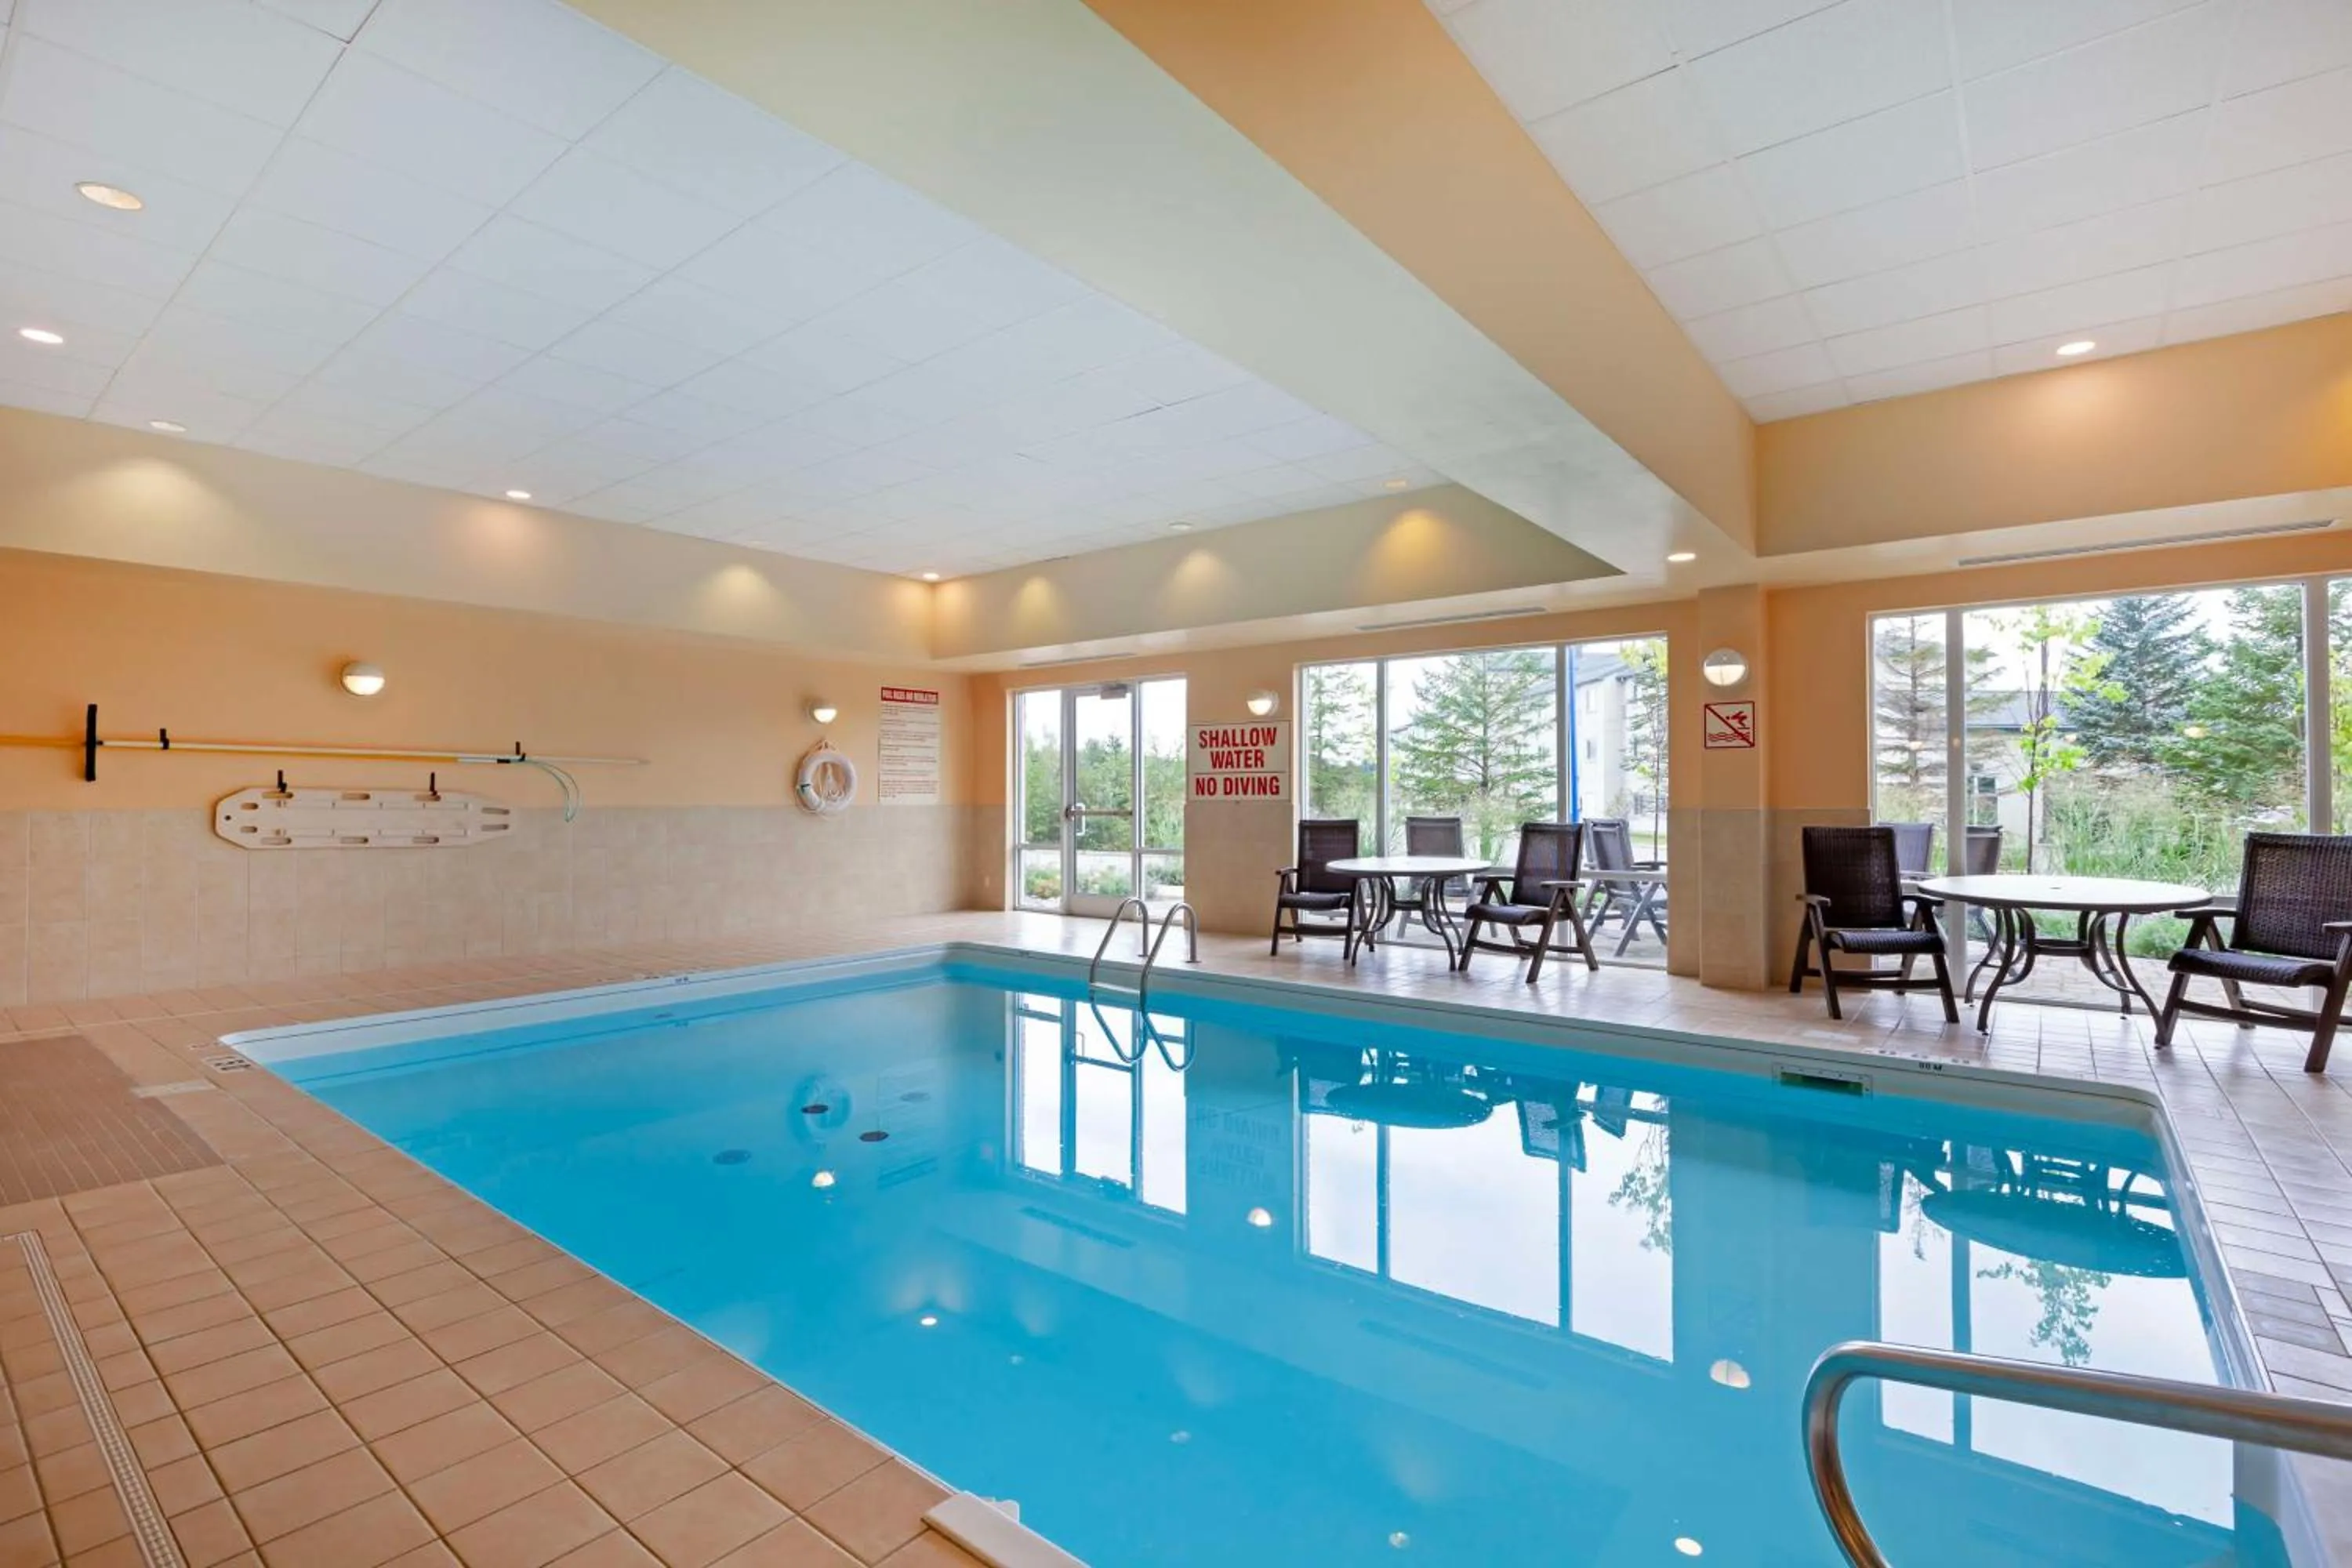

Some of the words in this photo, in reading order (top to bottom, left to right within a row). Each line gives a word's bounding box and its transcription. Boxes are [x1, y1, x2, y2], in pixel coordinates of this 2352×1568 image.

[1199, 727, 1277, 749] SHALLOW
[1210, 749, 1265, 769] WATER
[1196, 777, 1218, 796] NO
[1223, 775, 1280, 796] DIVING
